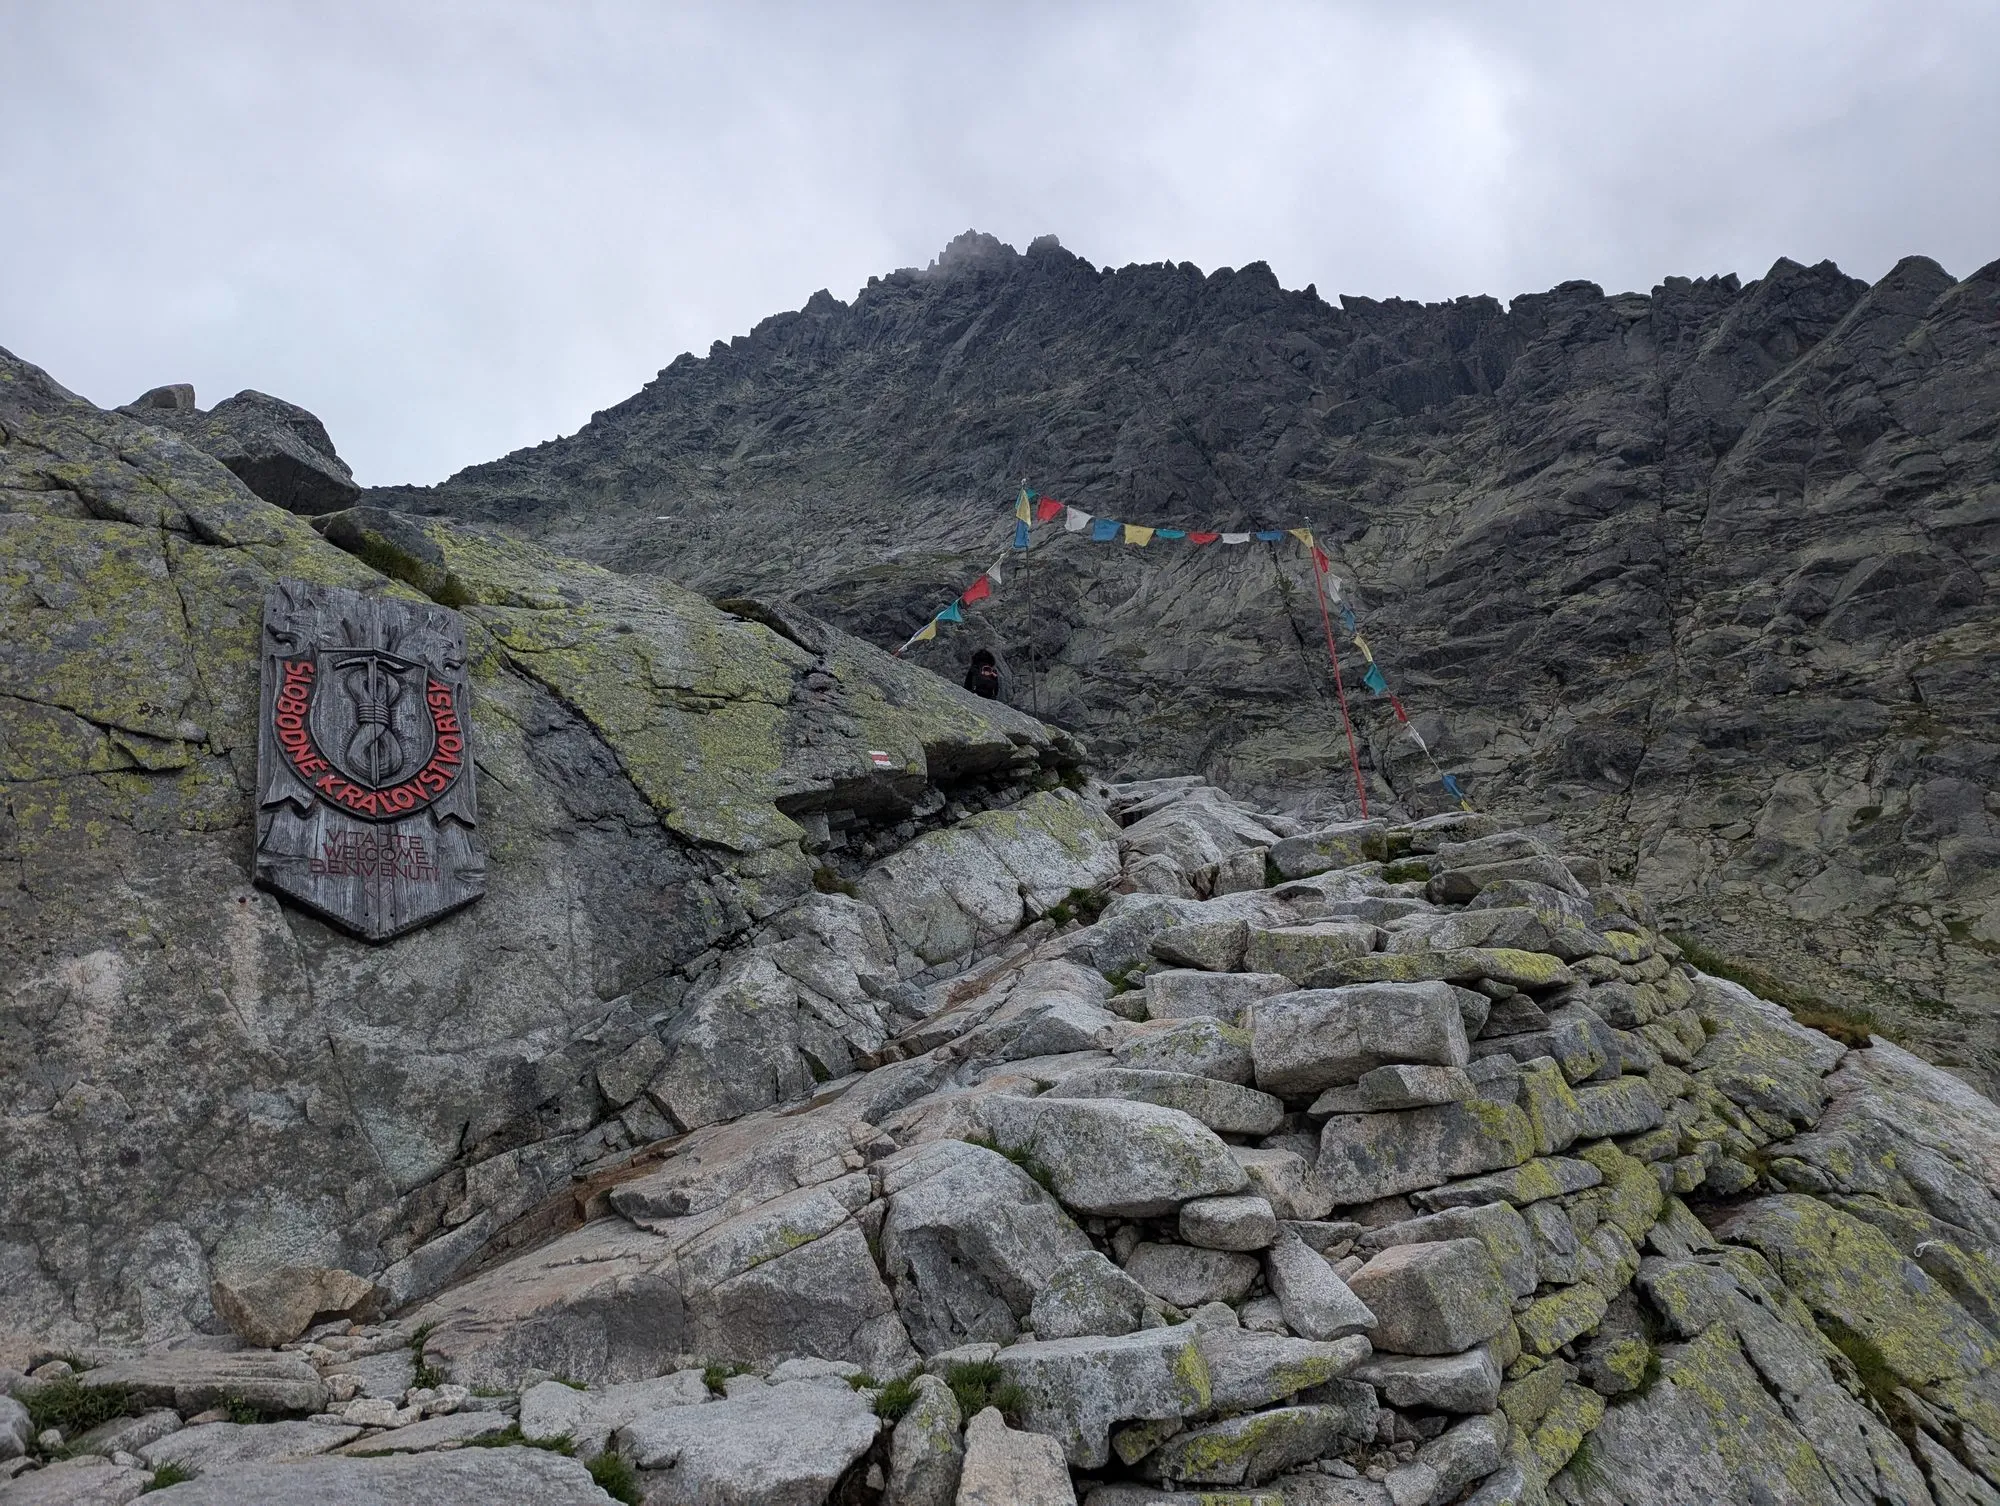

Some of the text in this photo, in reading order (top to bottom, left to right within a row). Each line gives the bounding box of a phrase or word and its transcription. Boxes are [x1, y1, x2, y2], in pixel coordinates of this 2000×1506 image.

[276, 660, 329, 778] SLOBODNÉ
[427, 679, 461, 733] RYSY
[325, 828, 424, 851] VITAJTE
[321, 842, 430, 865] WELCOME
